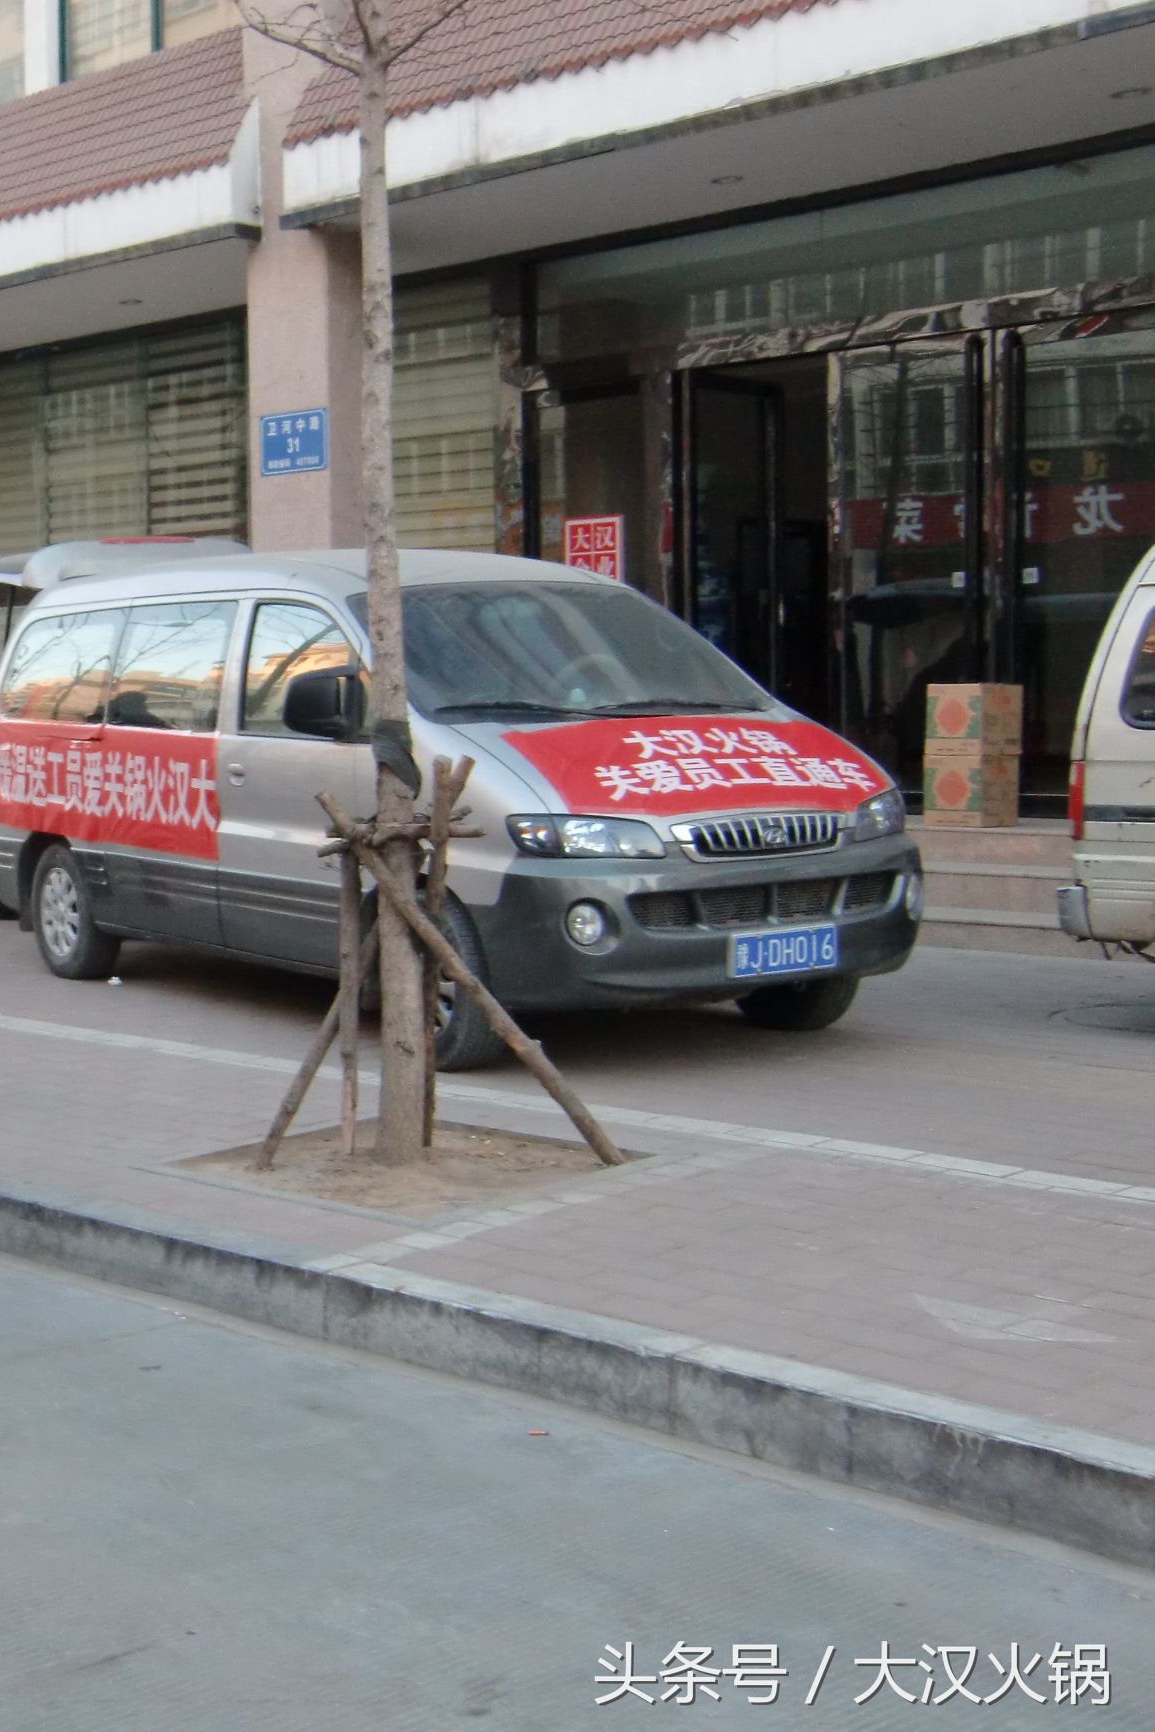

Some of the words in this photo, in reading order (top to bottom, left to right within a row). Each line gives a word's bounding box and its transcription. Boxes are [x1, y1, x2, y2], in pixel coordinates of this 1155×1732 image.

[286, 437, 300, 454] 31
[571, 526, 615, 550] 大汉
[622, 727, 798, 759] 大汉火锅
[594, 756, 877, 802] 关爱员工直通车
